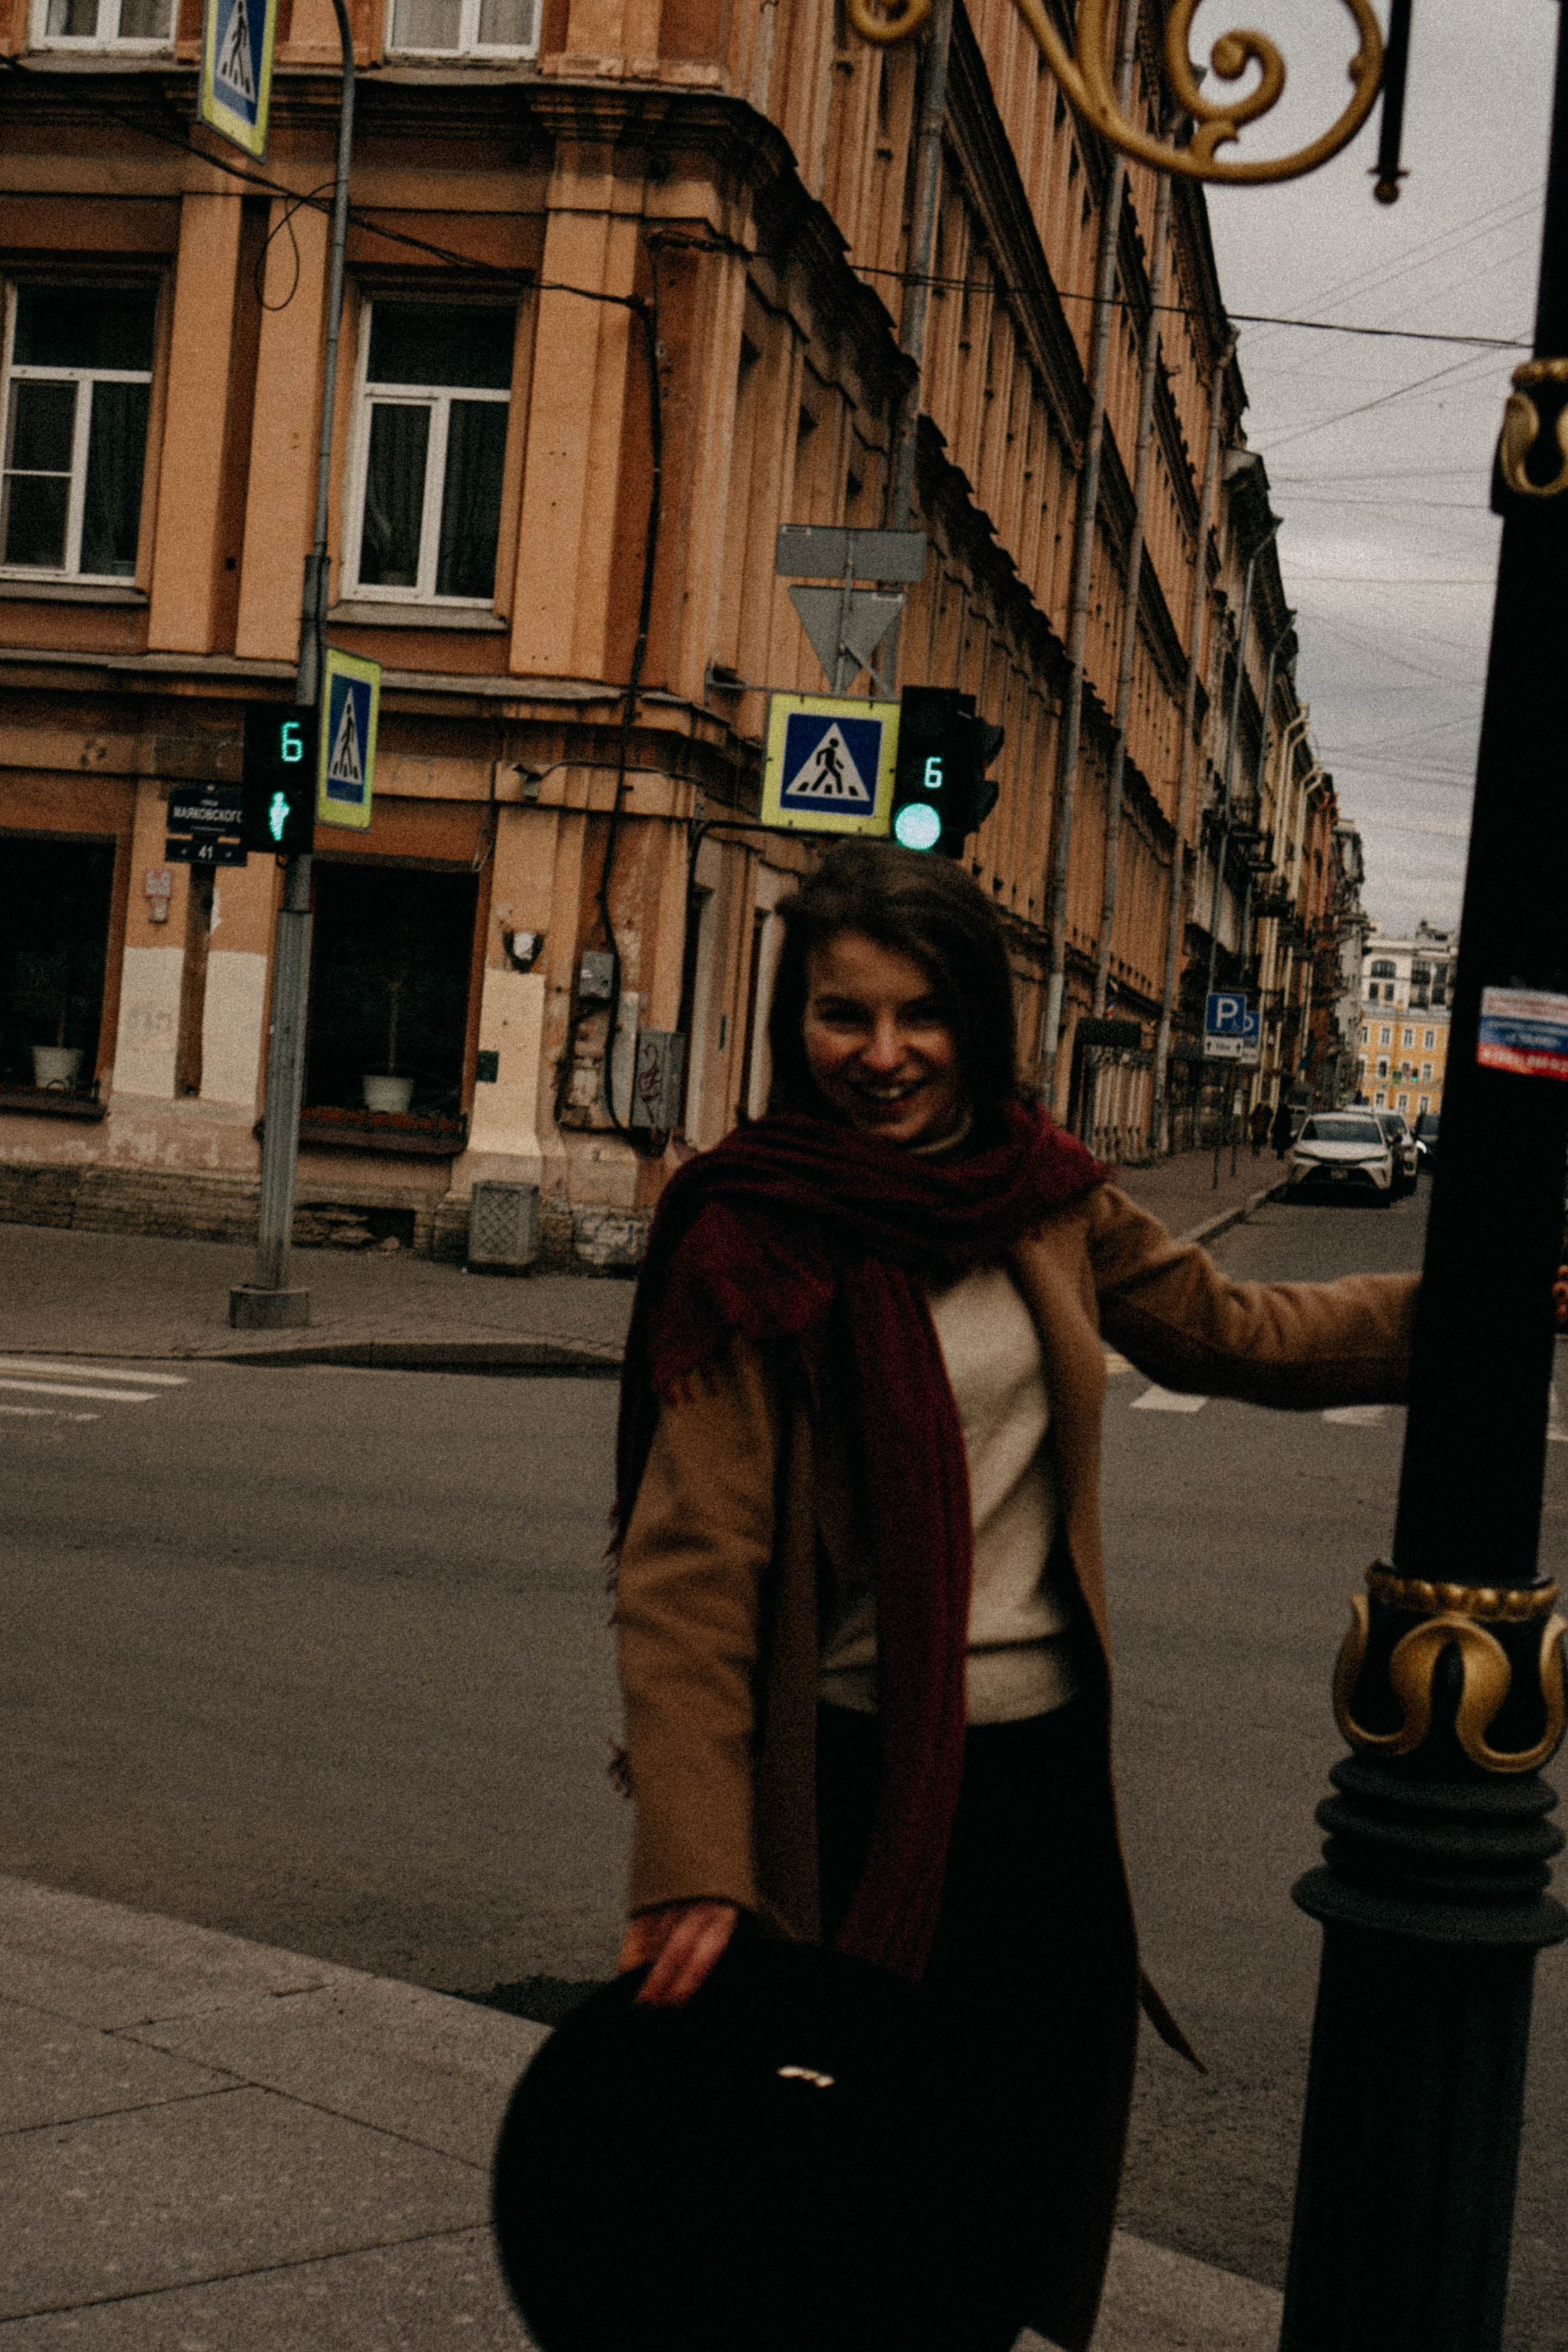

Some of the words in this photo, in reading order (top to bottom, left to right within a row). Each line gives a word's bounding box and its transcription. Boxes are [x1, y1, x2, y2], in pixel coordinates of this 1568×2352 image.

[282, 722, 303, 761] 6
[924, 756, 943, 788] 6
[198, 844, 214, 859] 41
[1216, 998, 1238, 1028] P
